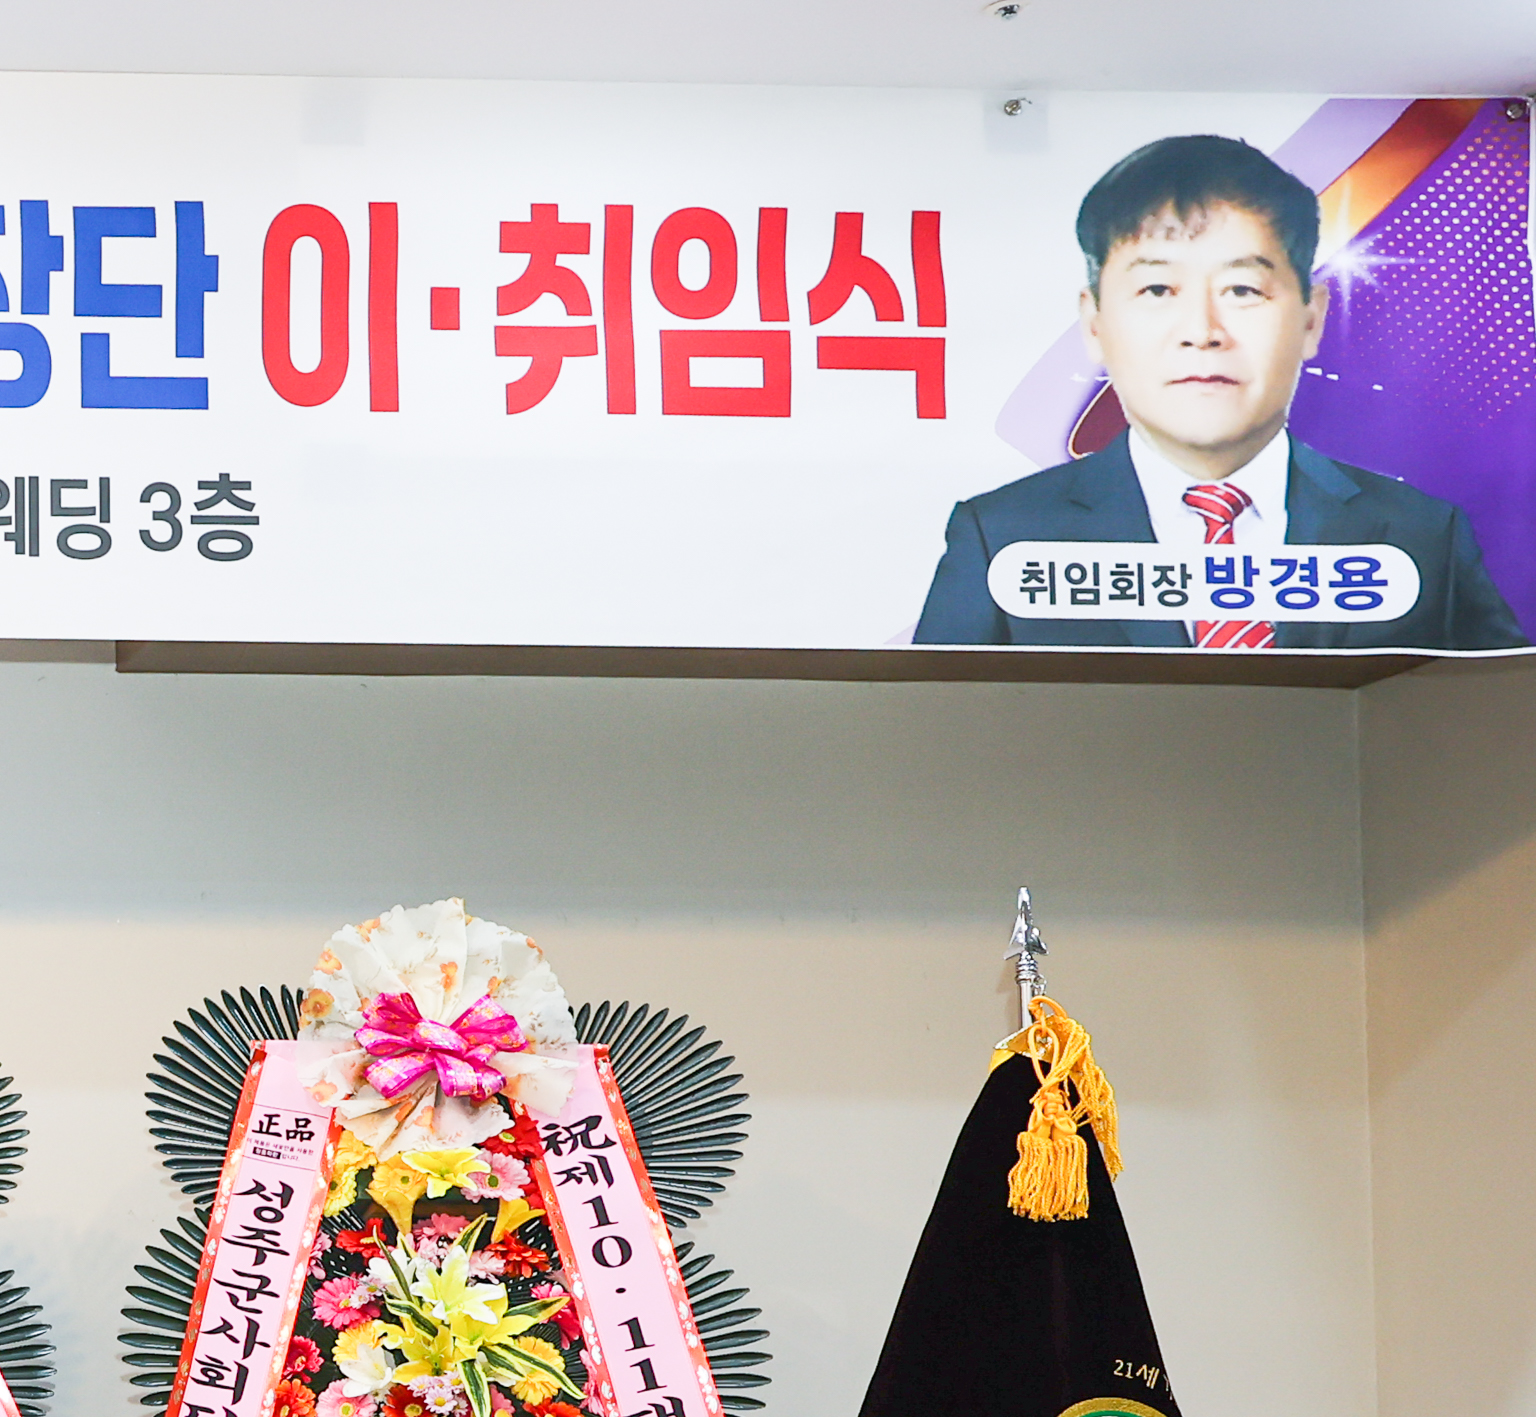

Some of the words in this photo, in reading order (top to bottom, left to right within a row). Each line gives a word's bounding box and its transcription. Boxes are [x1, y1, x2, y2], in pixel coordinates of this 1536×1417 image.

[137, 472, 260, 562] 3층
[1019, 560, 1192, 608] 취임회장
[1200, 553, 1389, 613] 방경용
[252, 1114, 315, 1142] 正品
